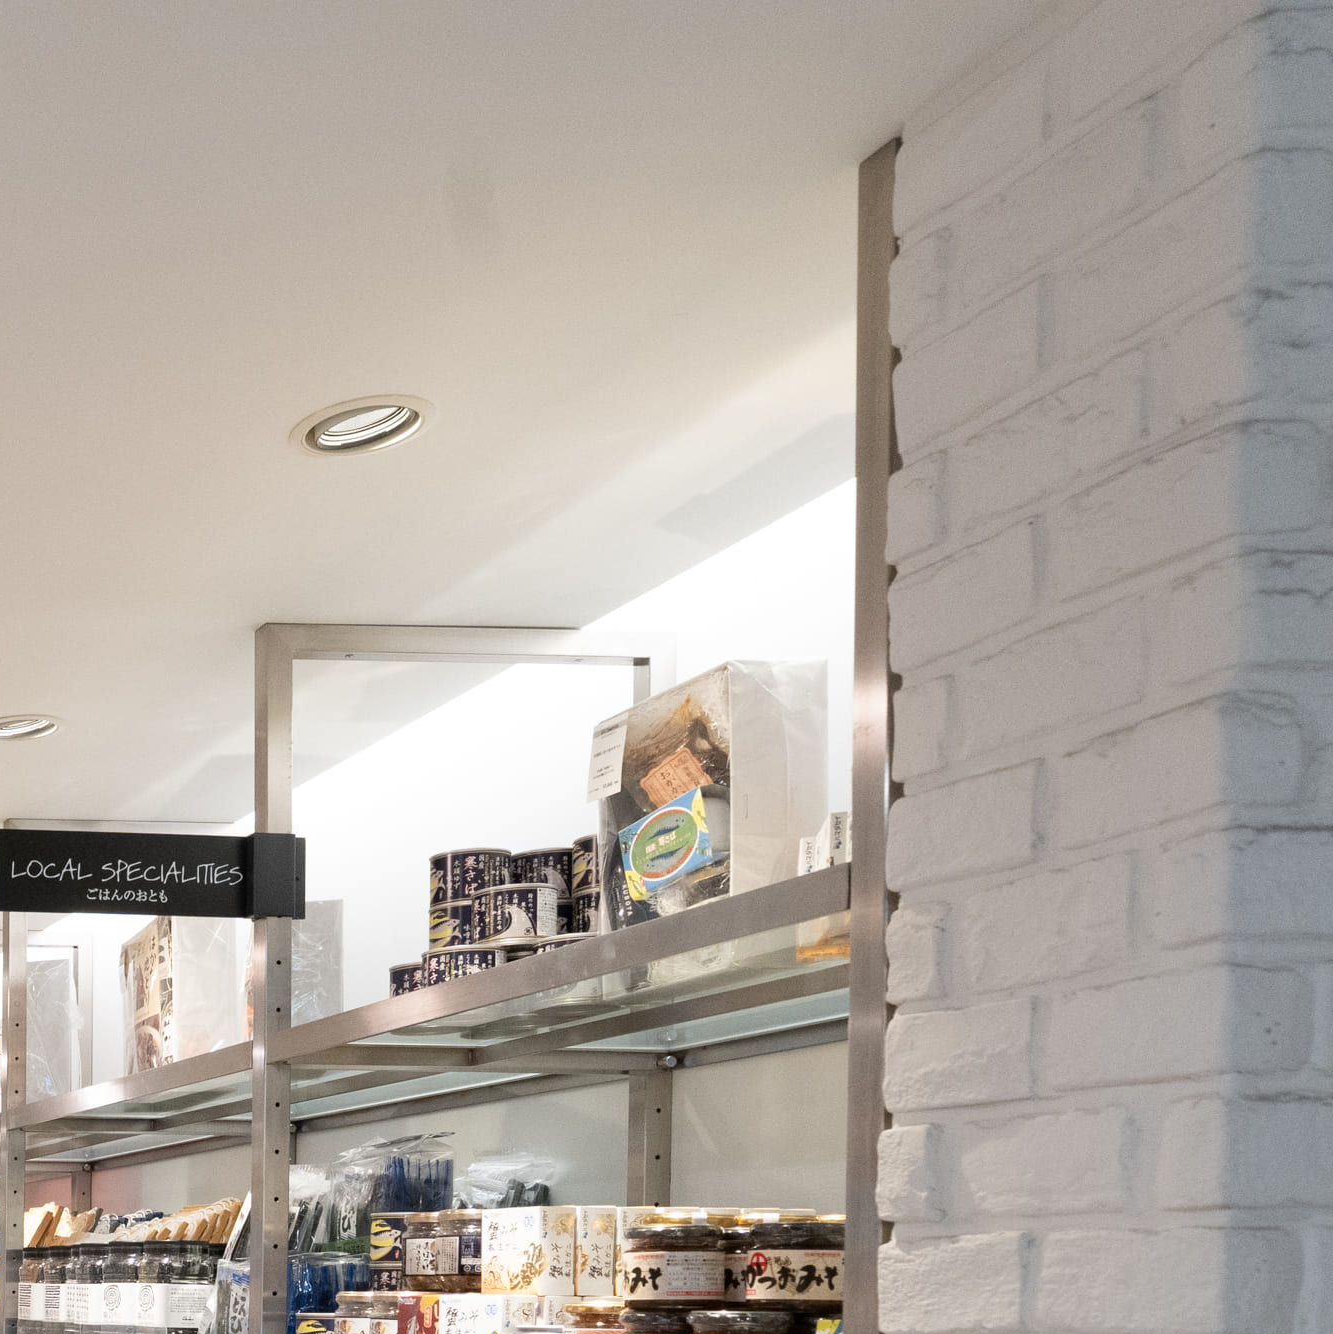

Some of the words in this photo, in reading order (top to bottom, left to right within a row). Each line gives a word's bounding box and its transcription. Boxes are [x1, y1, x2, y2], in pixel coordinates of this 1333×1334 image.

[10, 858, 93, 882] LOCAL
[100, 859, 245, 886] SPECIALITIES
[85, 888, 169, 904] ごはんのおとも
